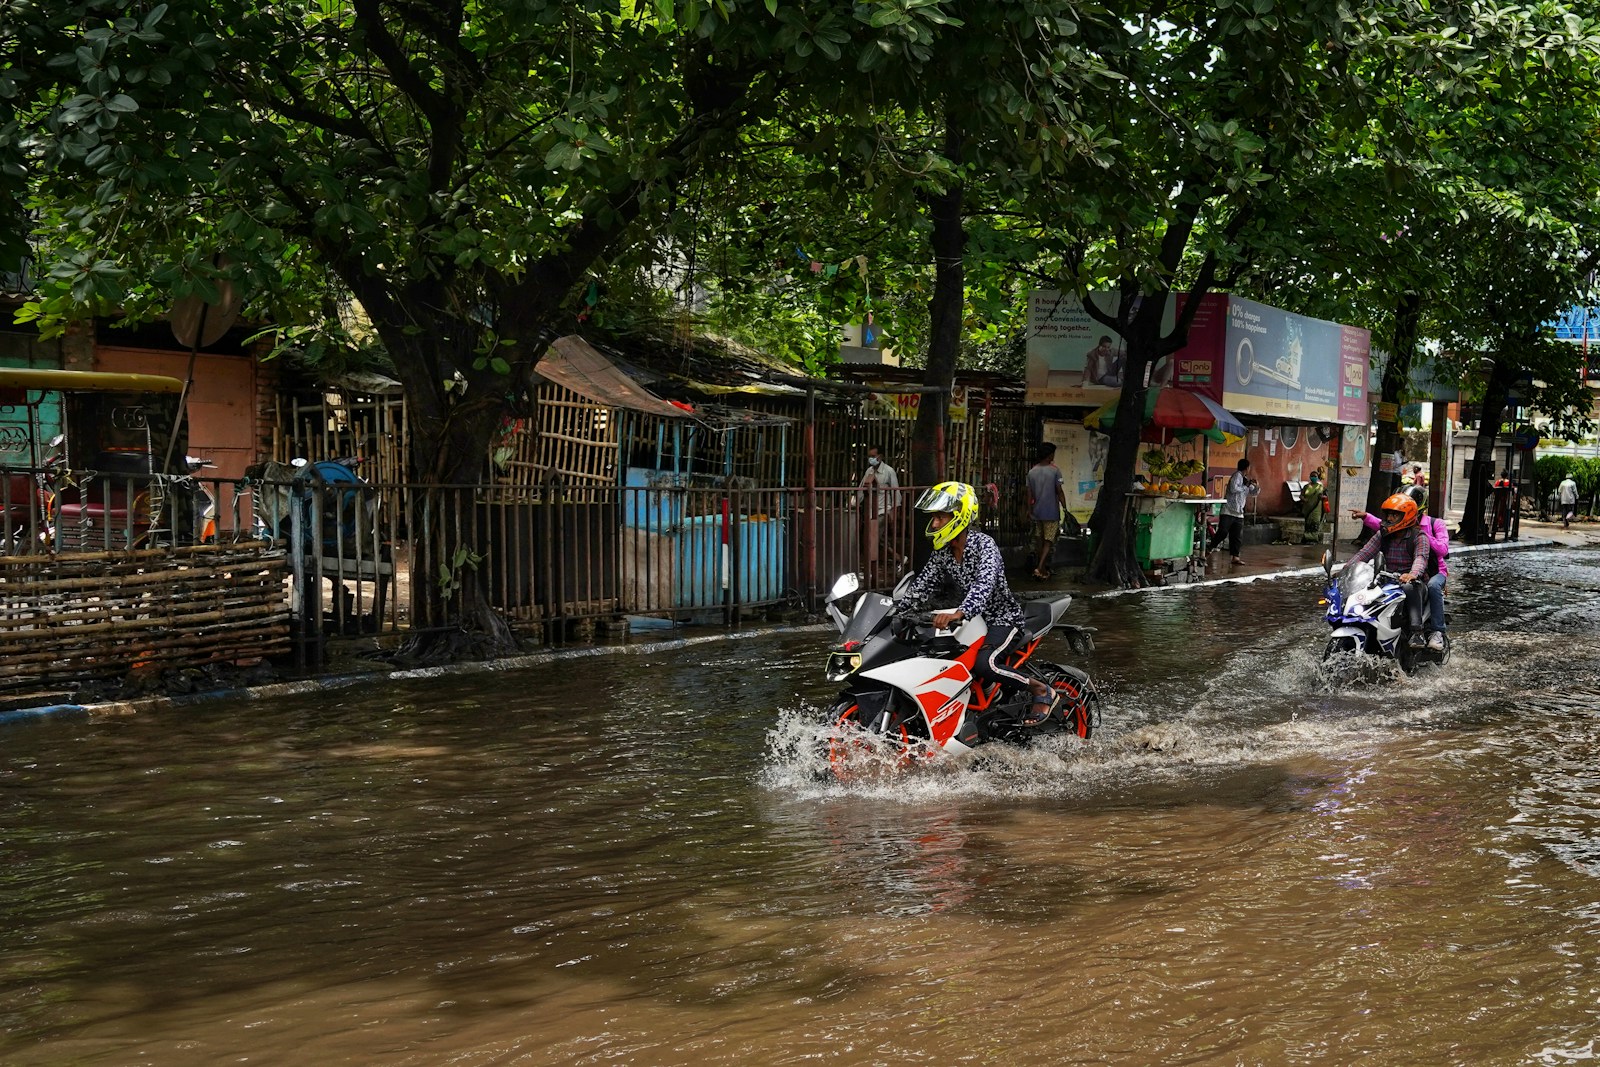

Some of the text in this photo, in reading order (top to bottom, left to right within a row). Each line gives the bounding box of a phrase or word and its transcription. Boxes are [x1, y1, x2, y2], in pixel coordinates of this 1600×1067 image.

[1232, 304, 1261, 323] 0% charges
[1034, 324, 1092, 332] coming together.
[1231, 318, 1268, 334] 100% happiness
[1193, 363, 1210, 373] pnb
